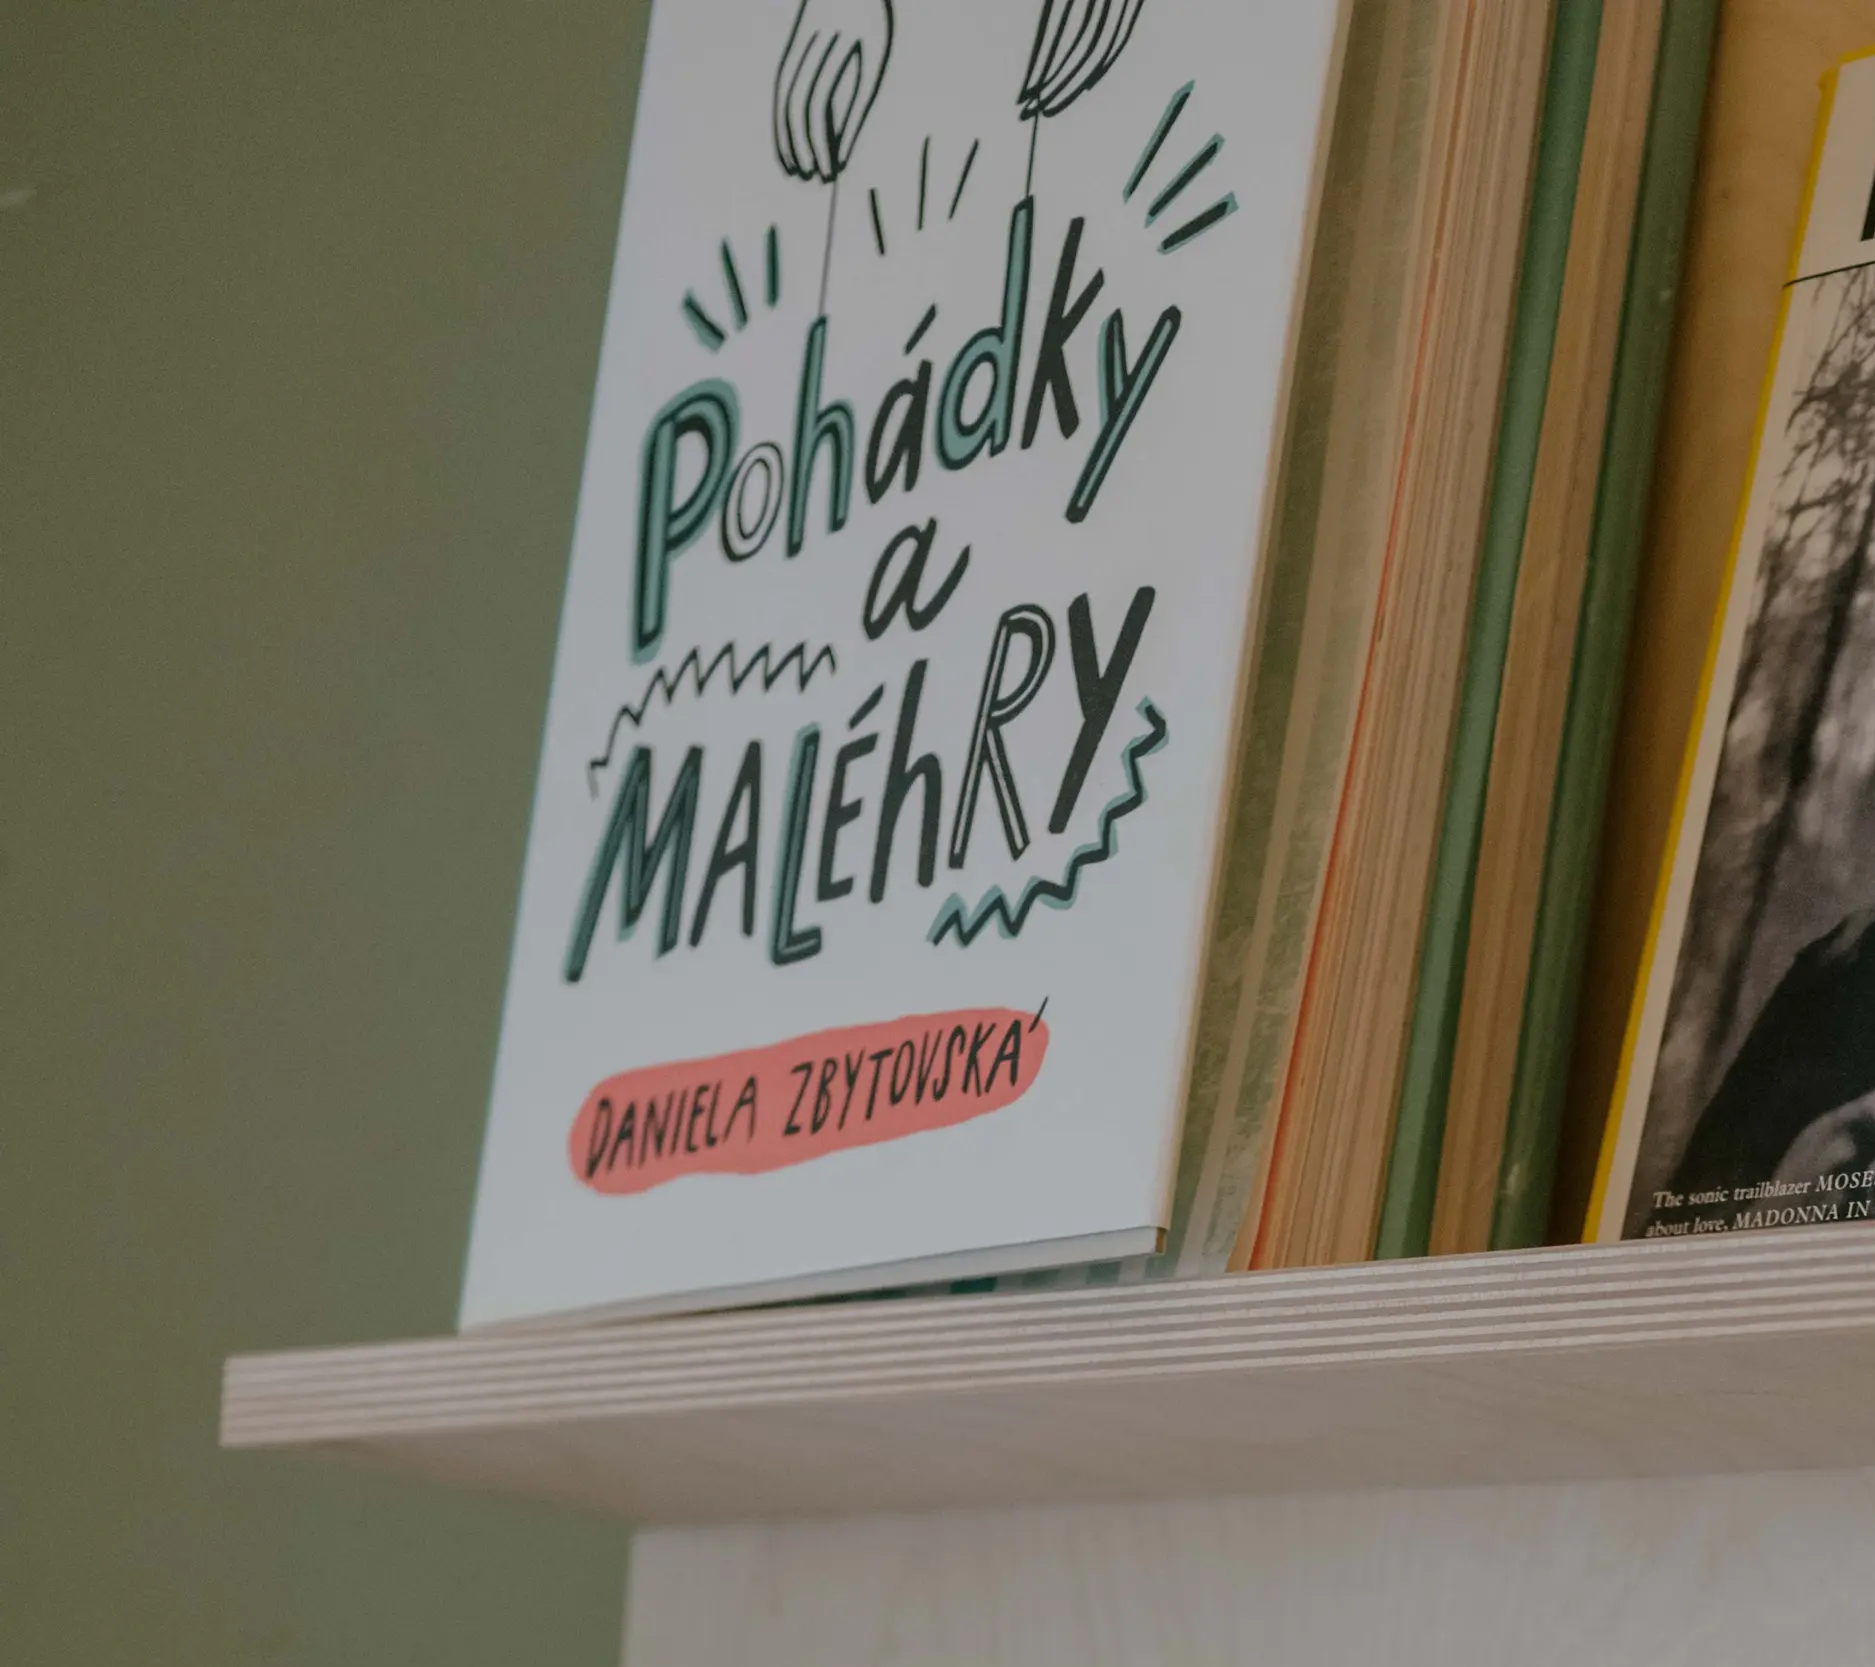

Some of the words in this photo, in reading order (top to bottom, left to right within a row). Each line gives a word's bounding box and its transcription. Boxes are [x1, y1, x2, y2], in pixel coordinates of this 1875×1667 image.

[862, 516, 971, 642] a
[584, 1075, 758, 1181] DANIELA
[780, 994, 1050, 1136] ZBYTOVSKÁ
[1652, 1190, 1683, 1209] The
[1688, 1185, 1730, 1206] sonic
[1733, 1178, 1812, 1202] trailblazer
[1692, 1214, 1729, 1235] love,
[1732, 1203, 1840, 1230] MADONNA
[1846, 1199, 1872, 1220] IN
